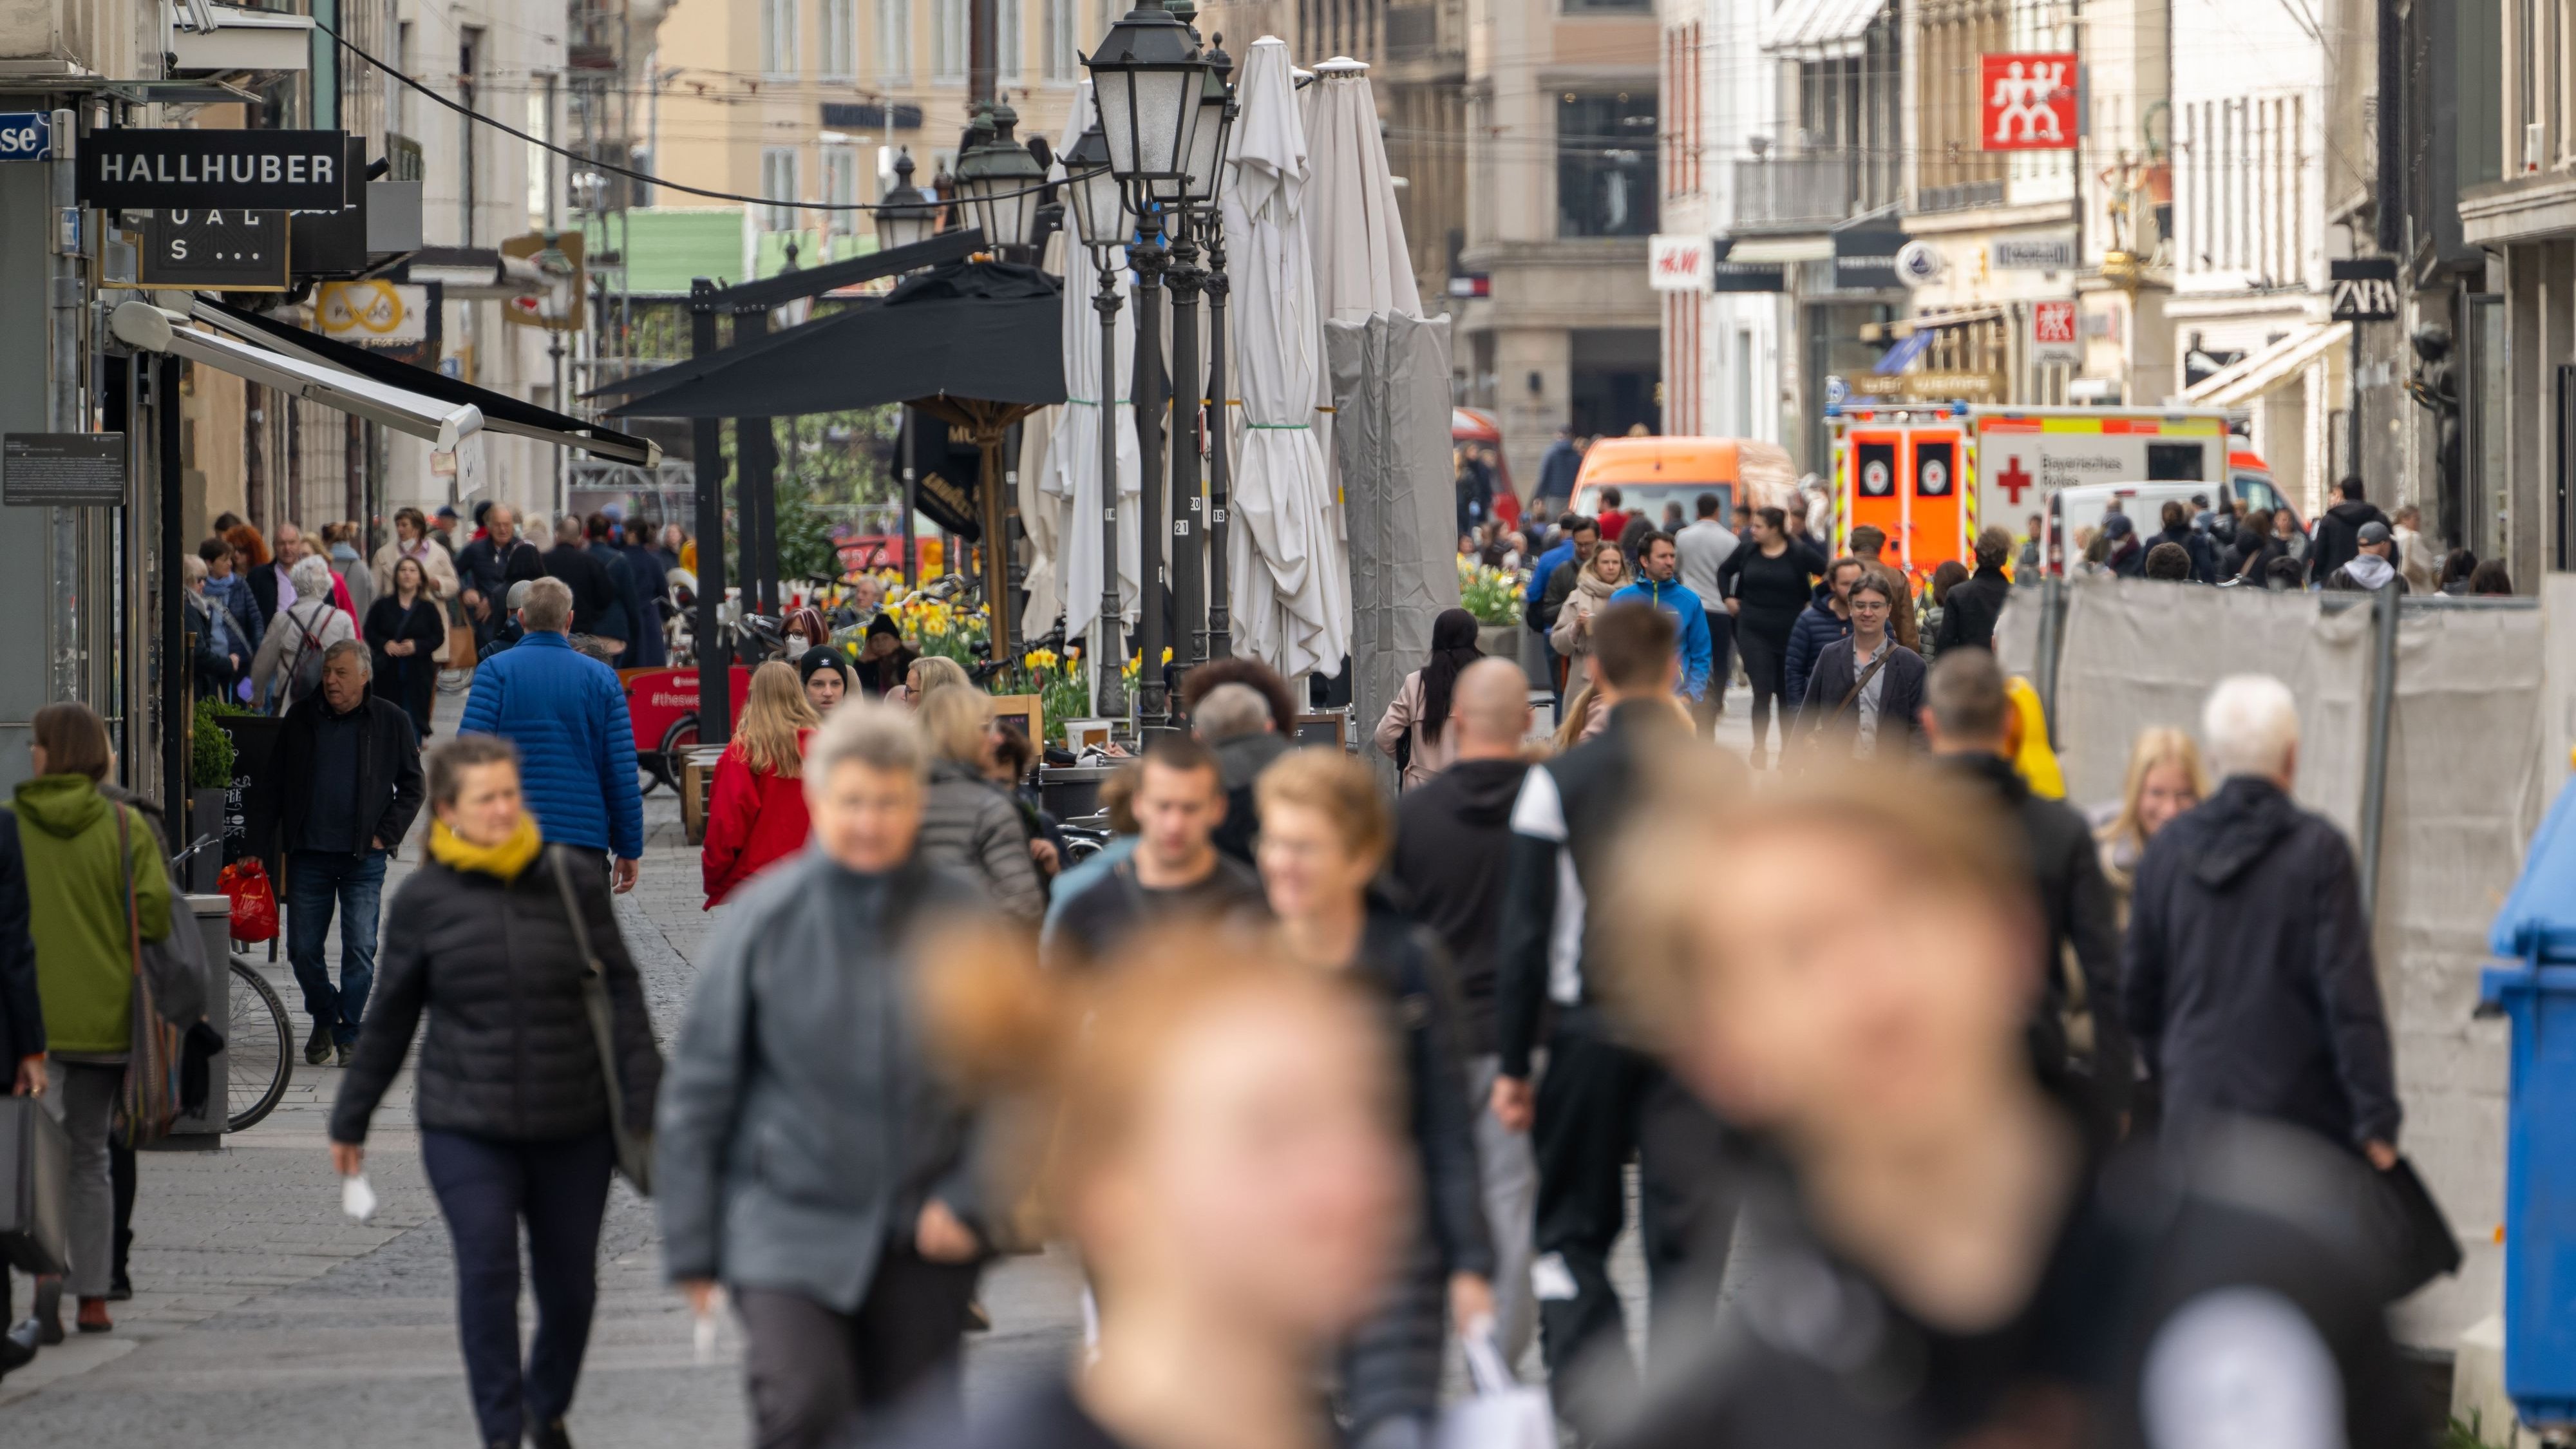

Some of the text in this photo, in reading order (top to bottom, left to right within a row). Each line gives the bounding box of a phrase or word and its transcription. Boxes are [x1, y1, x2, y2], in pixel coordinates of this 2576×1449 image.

[0, 128, 37, 152] se
[100, 154, 334, 184] HALLHUBER
[1215, 511, 1224, 520] 19
[1175, 522, 1187, 533] 21
